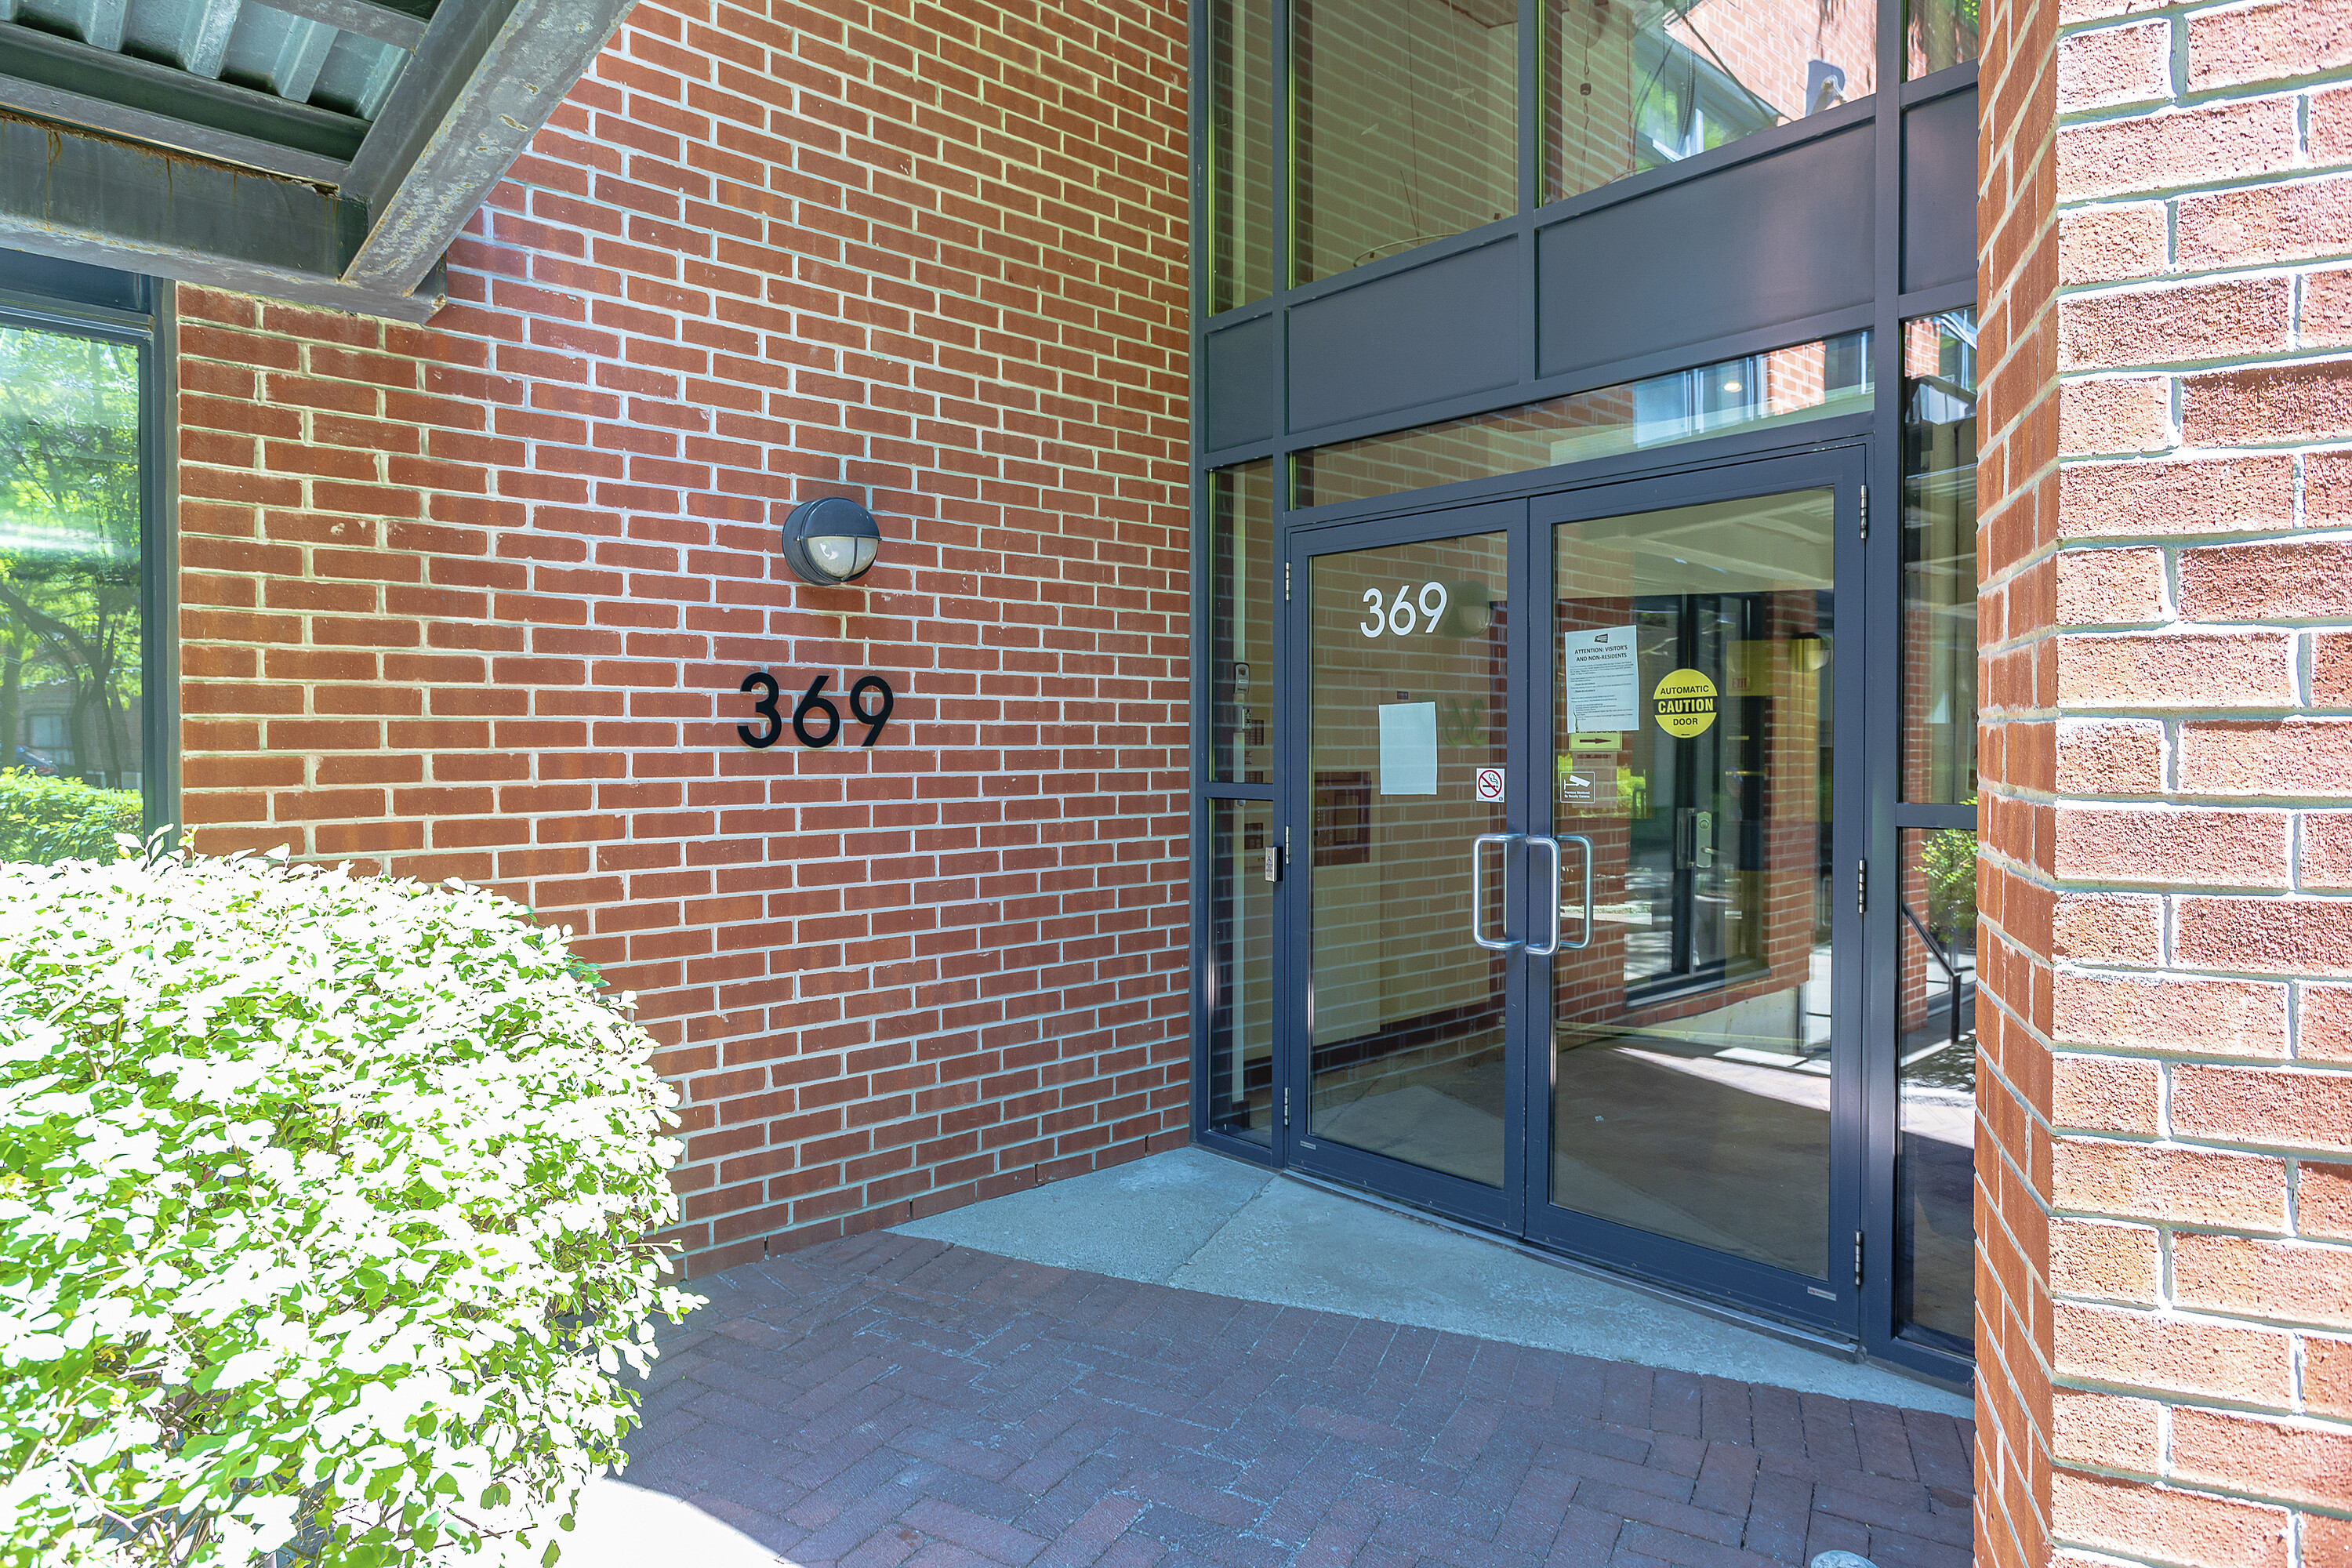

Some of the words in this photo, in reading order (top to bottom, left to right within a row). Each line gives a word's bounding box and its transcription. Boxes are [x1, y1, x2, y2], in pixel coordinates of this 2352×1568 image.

[1360, 581, 1448, 638] 369
[1588, 652, 1628, 661] NON-RESIDENTS
[1661, 684, 1709, 695] AUTOMATIC
[737, 671, 894, 749] 369
[1657, 698, 1714, 713] CAUTION
[1672, 717, 1698, 726] DOOR
